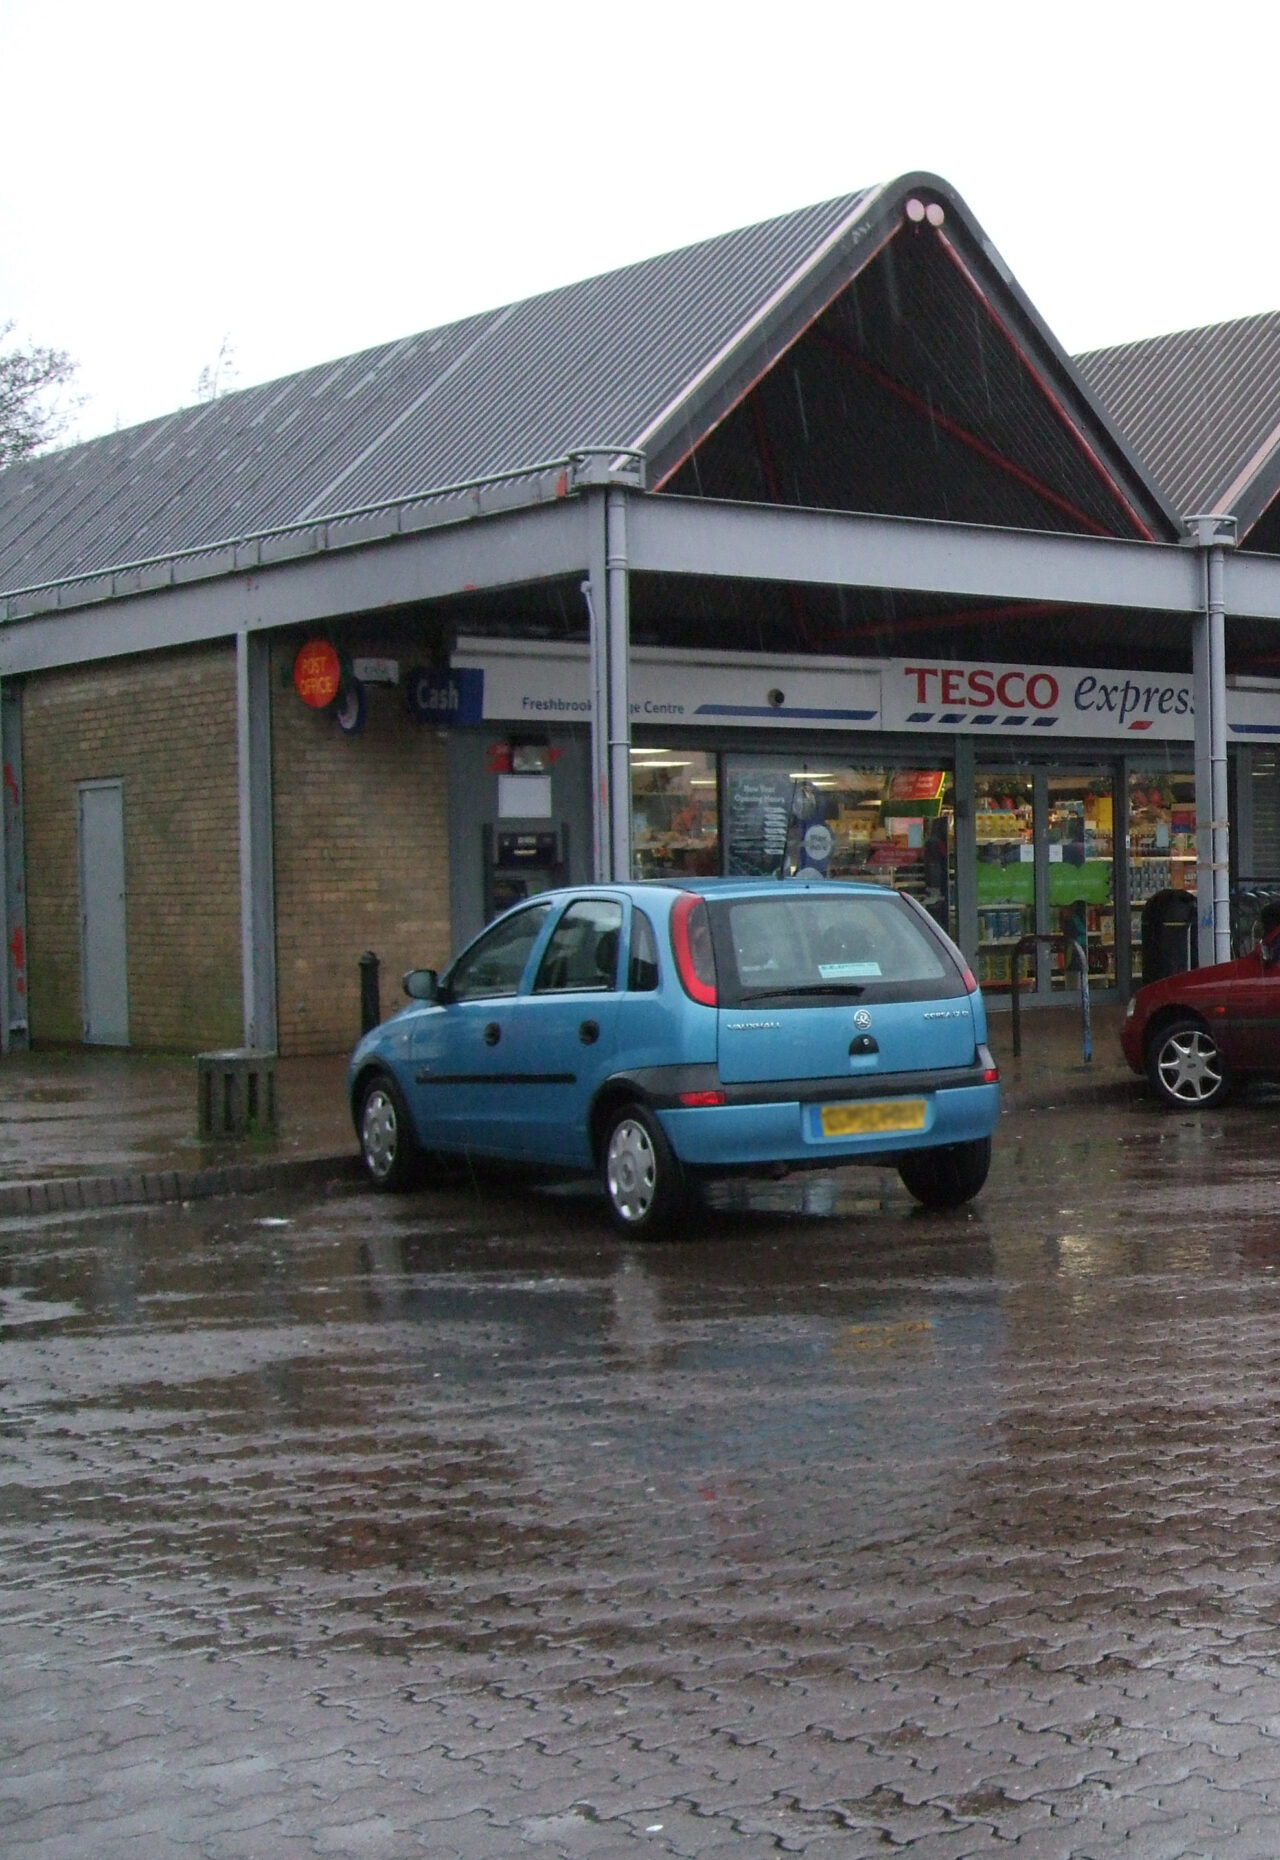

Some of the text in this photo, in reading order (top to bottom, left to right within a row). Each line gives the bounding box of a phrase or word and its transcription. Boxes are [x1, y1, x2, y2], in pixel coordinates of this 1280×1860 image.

[303, 656, 327, 674] POST
[301, 676, 333, 695] OFFICE
[417, 678, 459, 710] Cash
[905, 667, 1194, 724] TESCO expres
[644, 700, 684, 714] Centre
